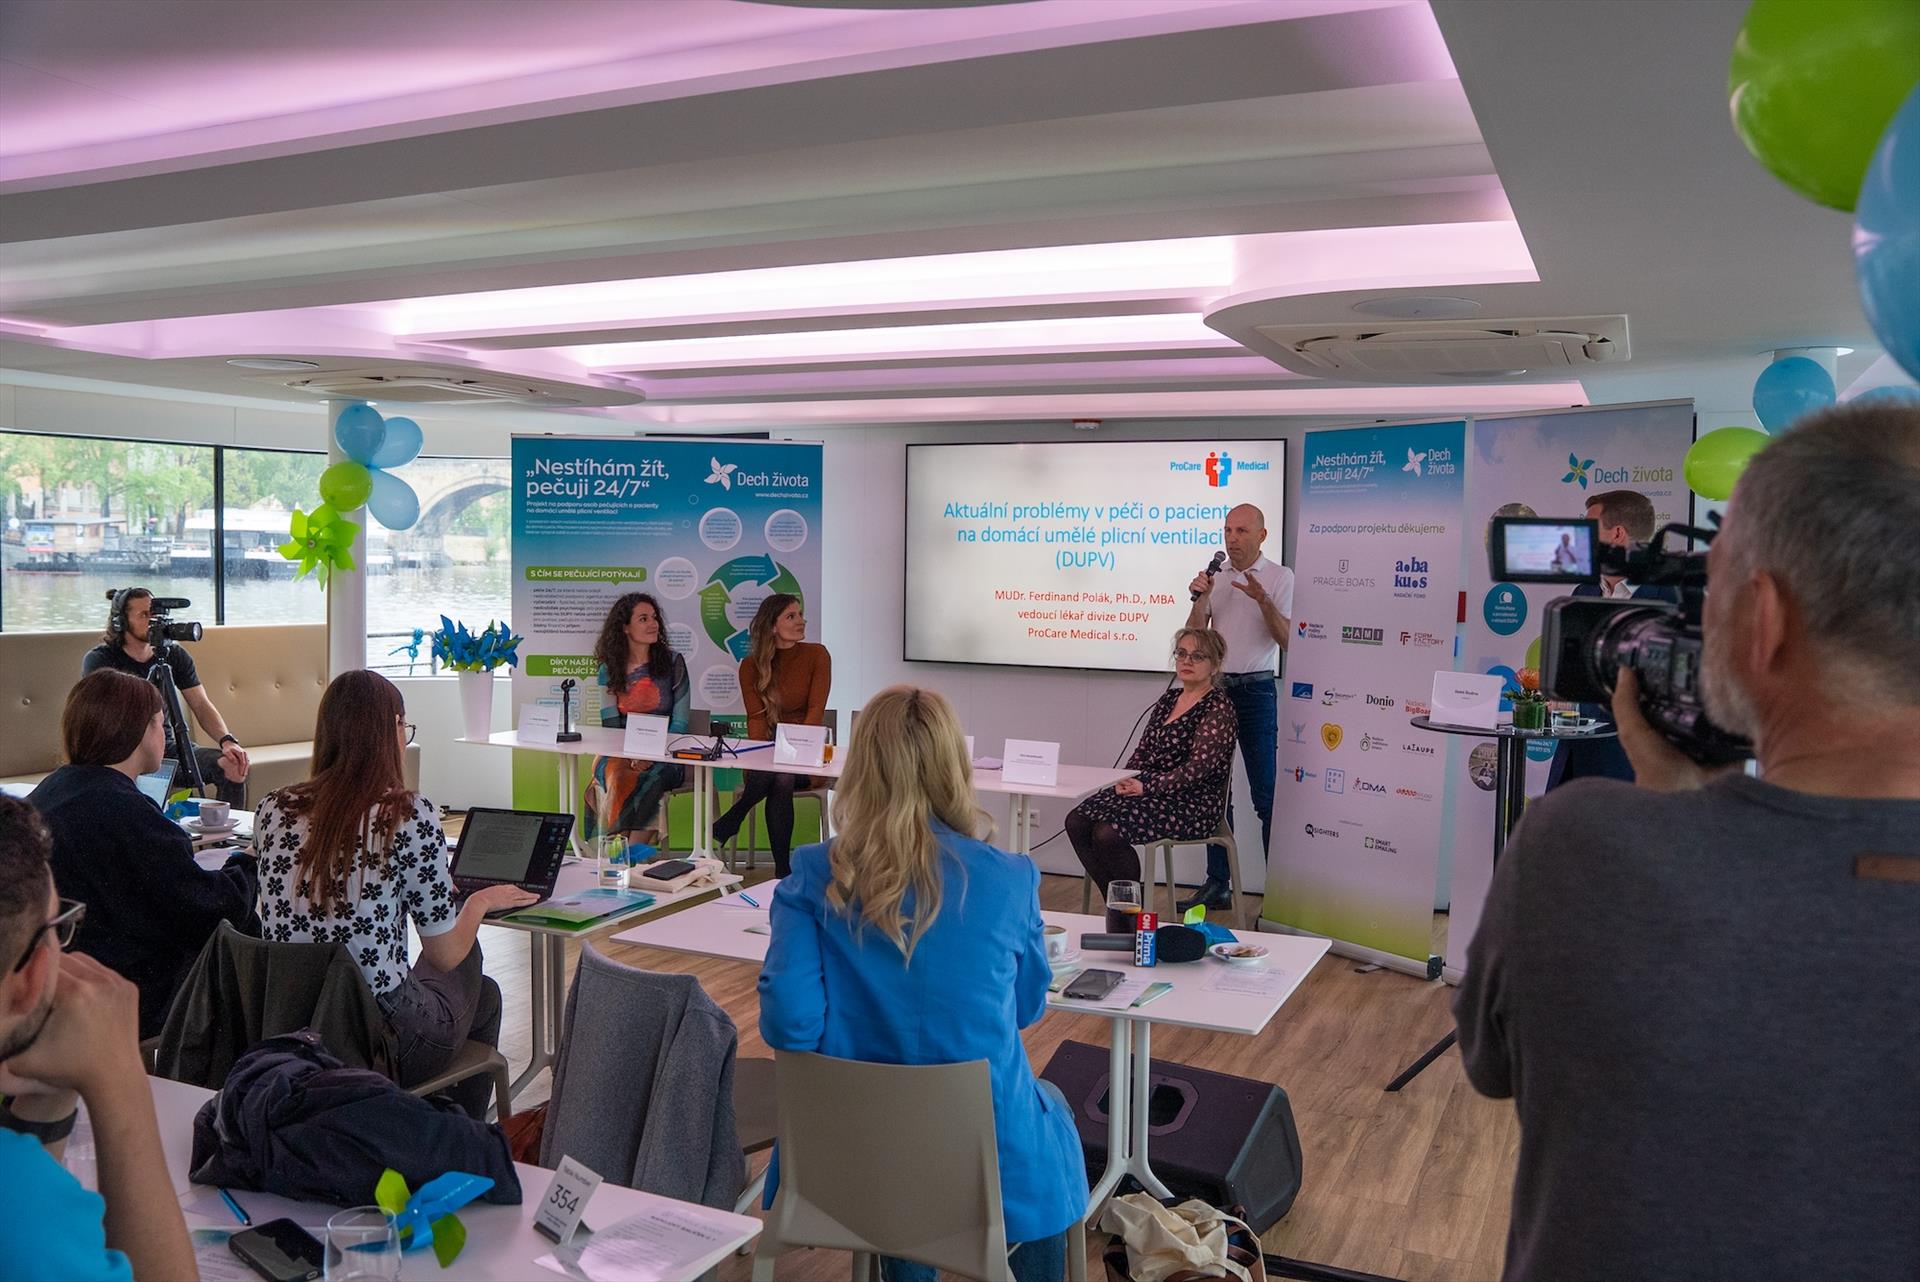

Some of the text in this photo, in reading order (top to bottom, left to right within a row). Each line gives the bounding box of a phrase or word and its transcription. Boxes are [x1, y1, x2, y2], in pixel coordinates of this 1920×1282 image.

[1311, 450, 1386, 469] „Nestíhám žít,
[1428, 448, 1451, 461] Dech
[526, 458, 669, 480] „Nestíhám žít,
[1170, 461, 1269, 471] ProCare Medical
[1427, 462, 1456, 475] života
[737, 472, 809, 488] Dech života
[1310, 468, 1343, 483] pečuji
[1594, 466, 1673, 484] Dech života
[526, 478, 650, 498] pečuji 24/7“
[943, 502, 1233, 522] Aktuální problémy v péči o pacient
[1309, 522, 1446, 536] Za podporu projektu děkujeme
[958, 526, 1222, 547] na domácí umělé plicní ventilaci
[1056, 550, 1115, 570] (DUPV)
[537, 569, 552, 578] ČÍM
[553, 570, 563, 578] SE
[564, 569, 600, 578] PEČUJÍCÍ
[601, 570, 640, 578] POTÝKAJÍ
[1312, 576, 1376, 588] PRAGUE BOATS
[995, 590, 1175, 606] MUDr. Ferdinand Polák, Ph.D., MBA
[1018, 609, 1149, 623] vedoucí lékař divize DUPV
[1028, 628, 1138, 642] ProCare Medical s.r.o.
[1414, 638, 1444, 646] FACTORY
[550, 658, 569, 666] DÍKY
[569, 658, 588, 666] NAŠÍ
[552, 666, 588, 674] PEČUJÍCÍ
[1366, 694, 1394, 707] Donio
[1405, 706, 1431, 715] BigBoar
[1362, 782, 1387, 794] DMA
[1374, 845, 1397, 854] EMAILING
[1375, 839, 1391, 847] SMART
[1143, 932, 1155, 964] Prima
[550, 1184, 580, 1216] 354
